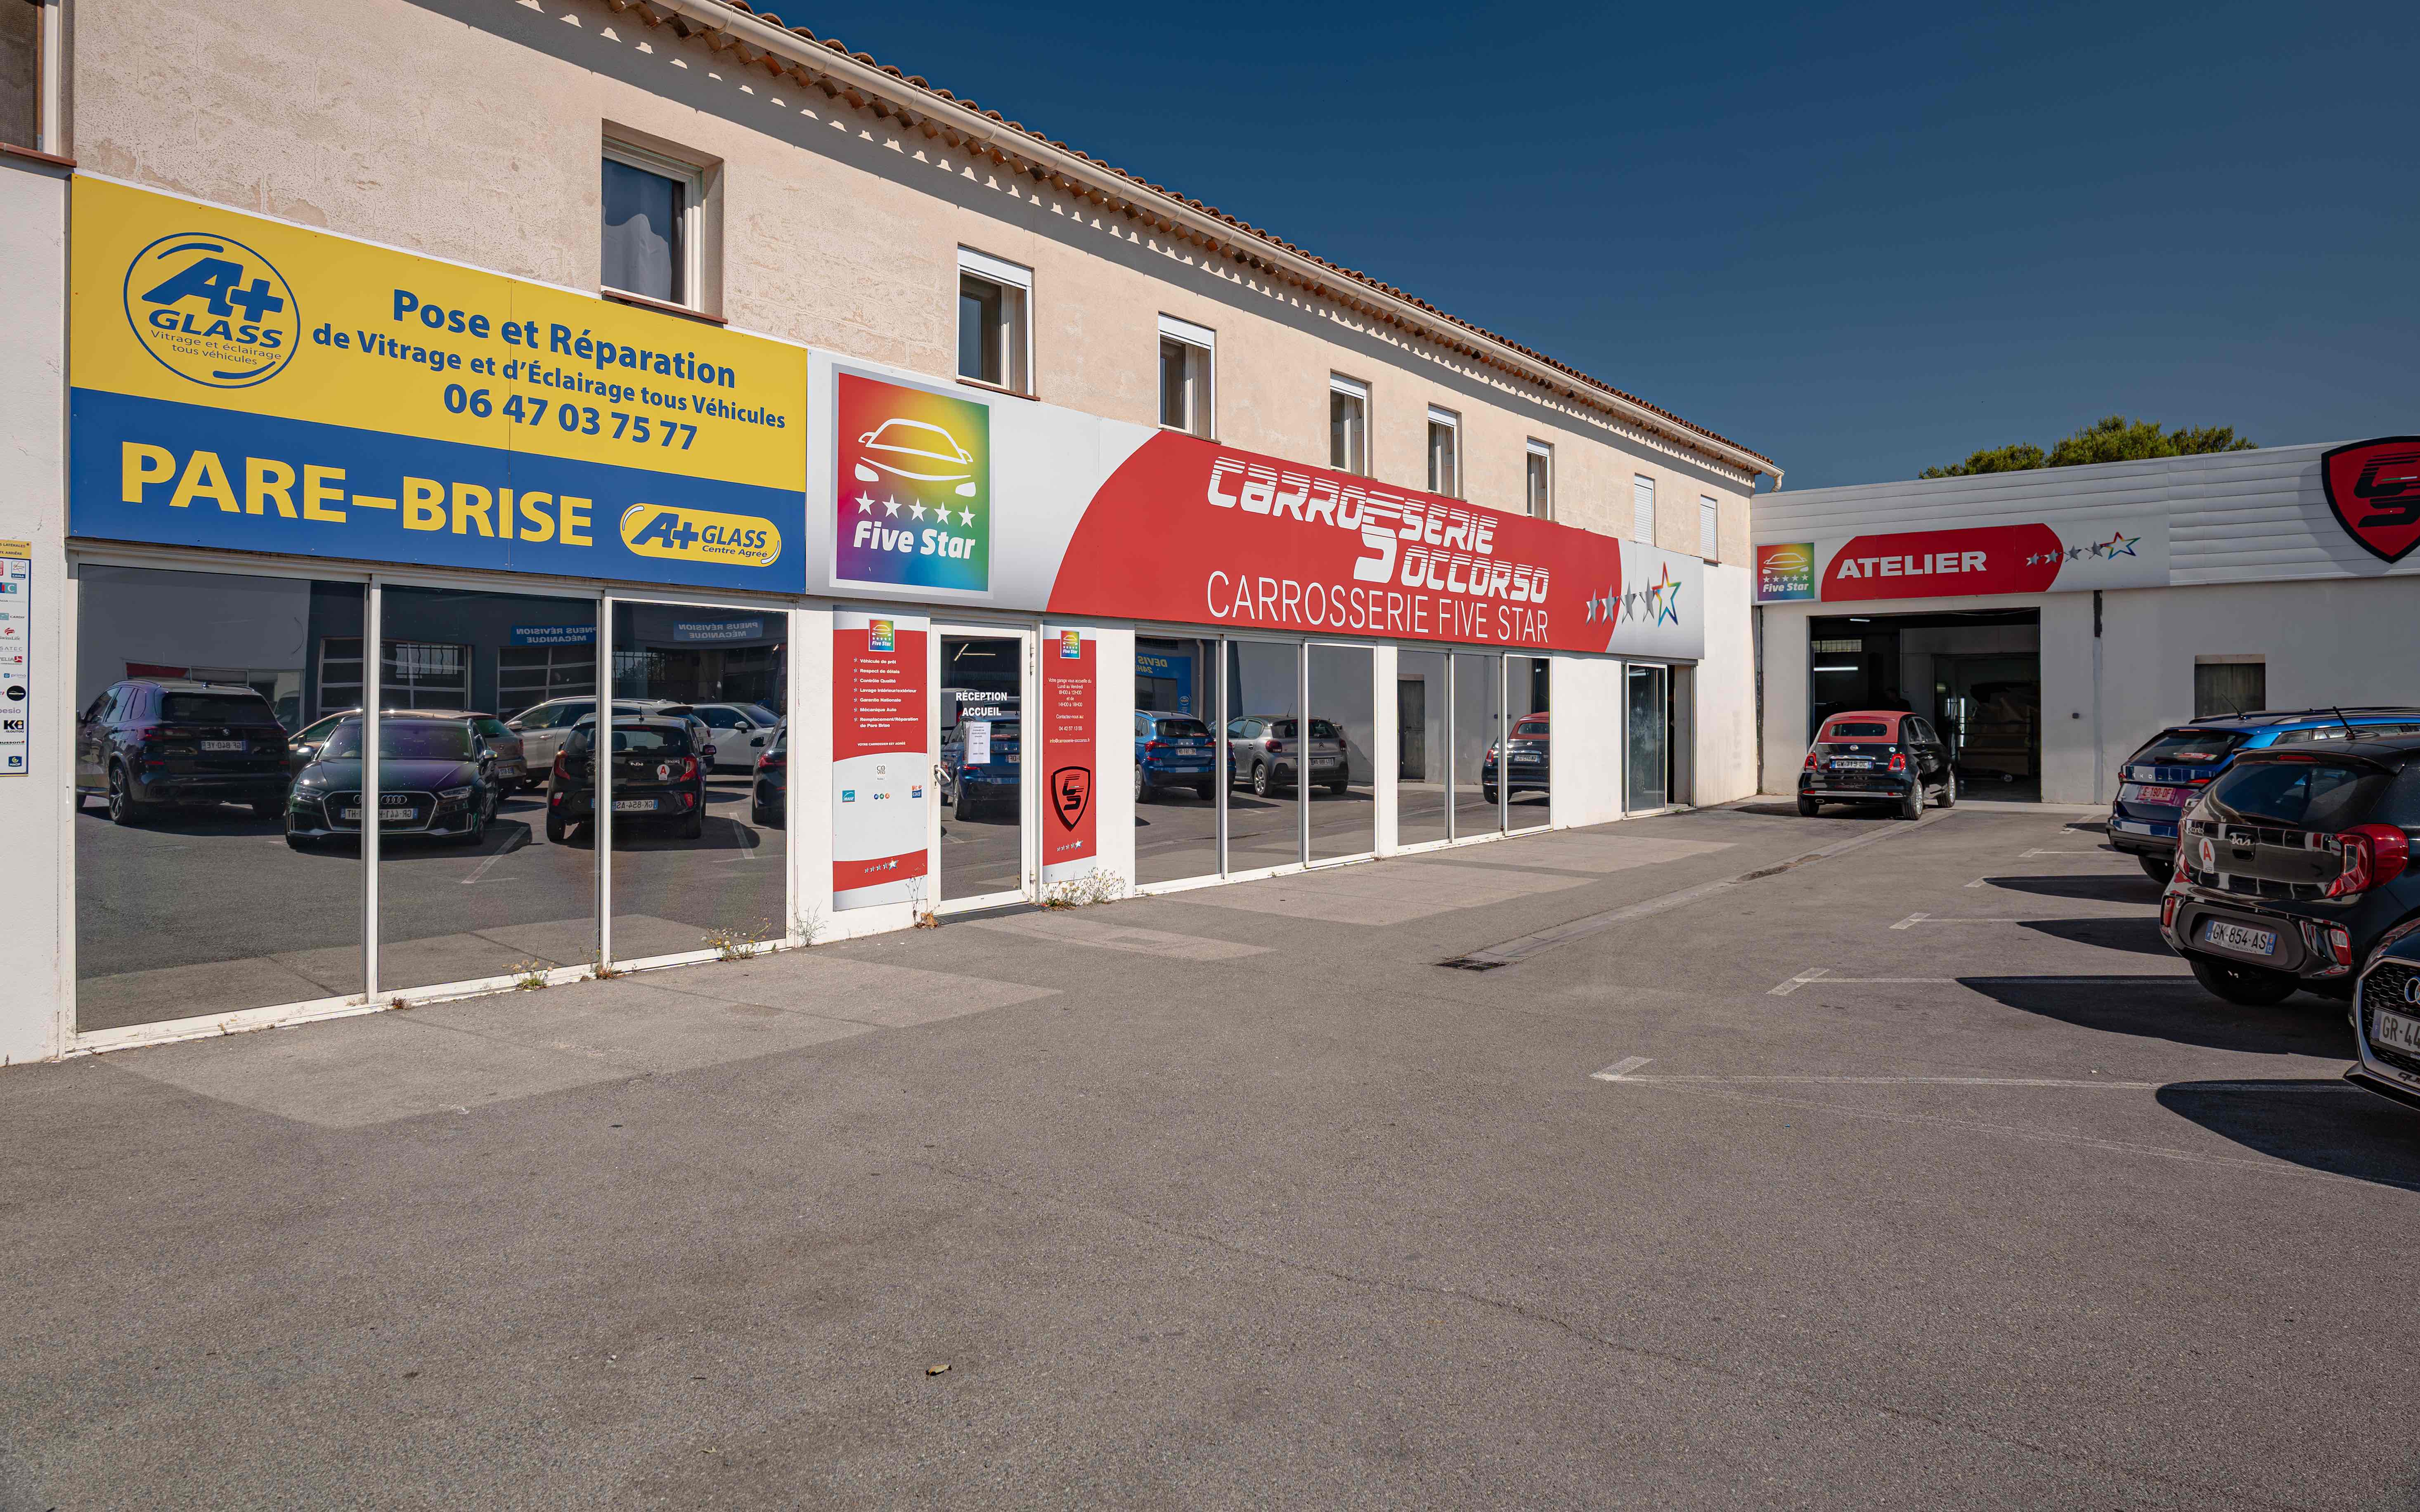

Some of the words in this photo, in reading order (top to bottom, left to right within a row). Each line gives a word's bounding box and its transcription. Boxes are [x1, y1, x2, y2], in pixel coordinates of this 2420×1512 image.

[149, 309, 283, 348] GLASS
[394, 289, 490, 338] Pose
[502, 321, 538, 349] et
[550, 323, 735, 388] Réparation
[151, 330, 201, 346] Vitrage
[206, 341, 218, 349] et
[223, 343, 282, 360] éclairage
[172, 344, 199, 355] tous
[202, 350, 257, 365] véhicules
[313, 323, 349, 349] de
[357, 330, 461, 372] Vitrage
[471, 357, 495, 376] et
[641, 387, 686, 411] tous
[692, 395, 785, 428] Véhicules
[444, 383, 492, 418] 06
[503, 395, 548, 426] 47
[558, 403, 600, 435] 03
[611, 411, 650, 443] 75
[660, 420, 697, 450] 77
[701, 525, 767, 549] GLASS
[853, 520, 914, 553] Five
[920, 528, 976, 559] Star
[702, 544, 736, 556] Centre
[738, 548, 768, 558] Agréé
[1837, 551, 1987, 579] ATELIER
[1763, 584, 1784, 592] Five
[1787, 583, 1809, 591] Star
[1207, 571, 1429, 634] CARROSSERIE
[1439, 598, 1488, 638] FIVE
[1498, 605, 1549, 643] STAR
[956, 690, 1008, 701] RÉCEPTION
[962, 707, 1001, 716] ACCUEIL
[2203, 841, 2212, 861] A
[2213, 924, 2267, 950] GK-854-AS
